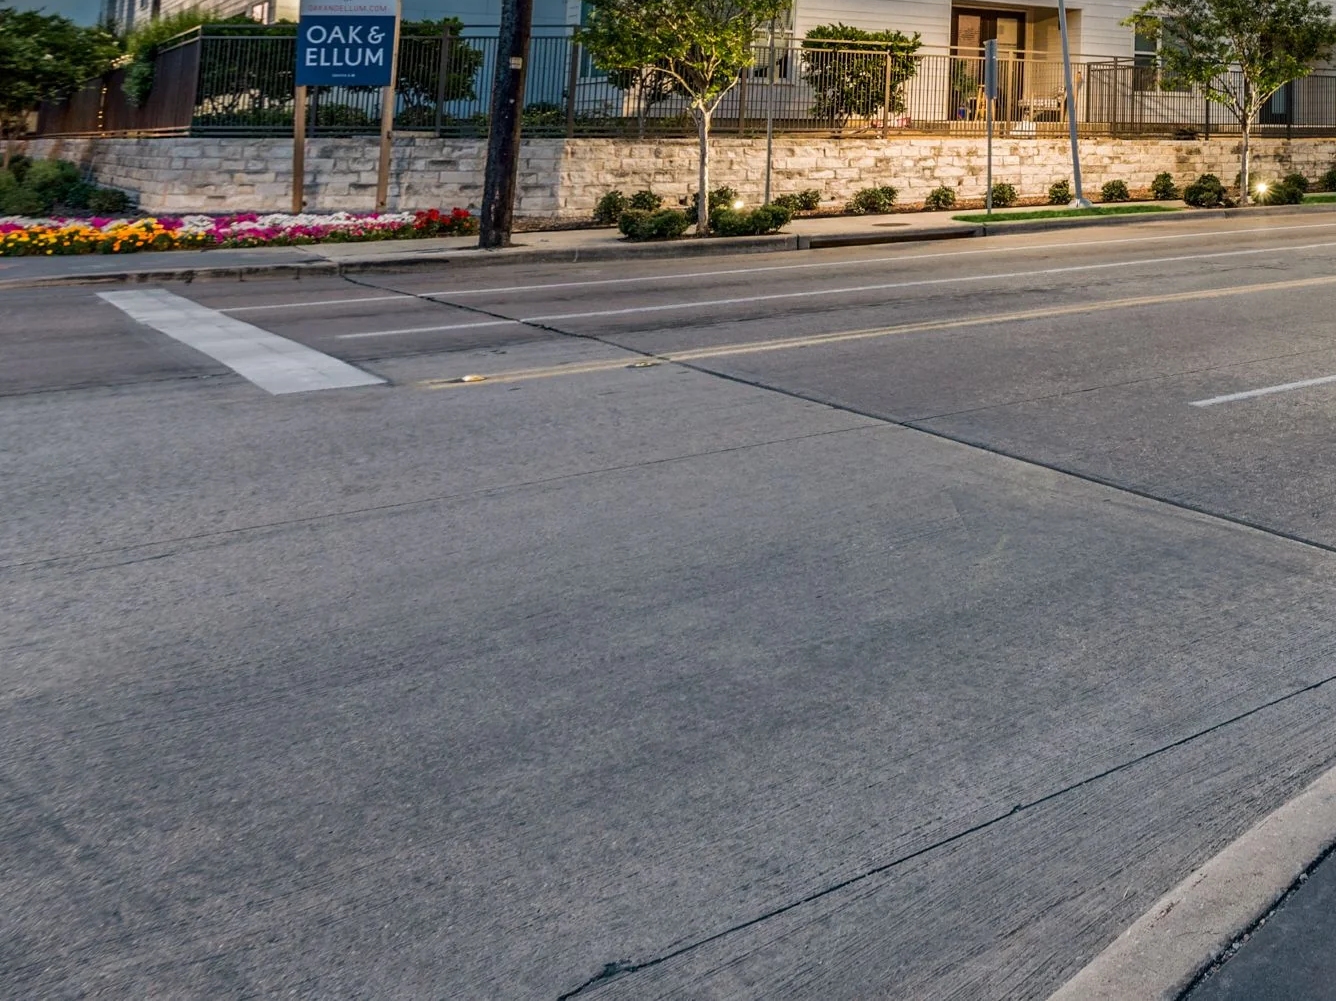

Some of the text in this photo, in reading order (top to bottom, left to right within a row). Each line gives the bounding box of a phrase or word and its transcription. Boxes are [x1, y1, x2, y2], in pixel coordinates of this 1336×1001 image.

[306, 25, 386, 44] OAK &
[305, 47, 384, 67] ELLUM
